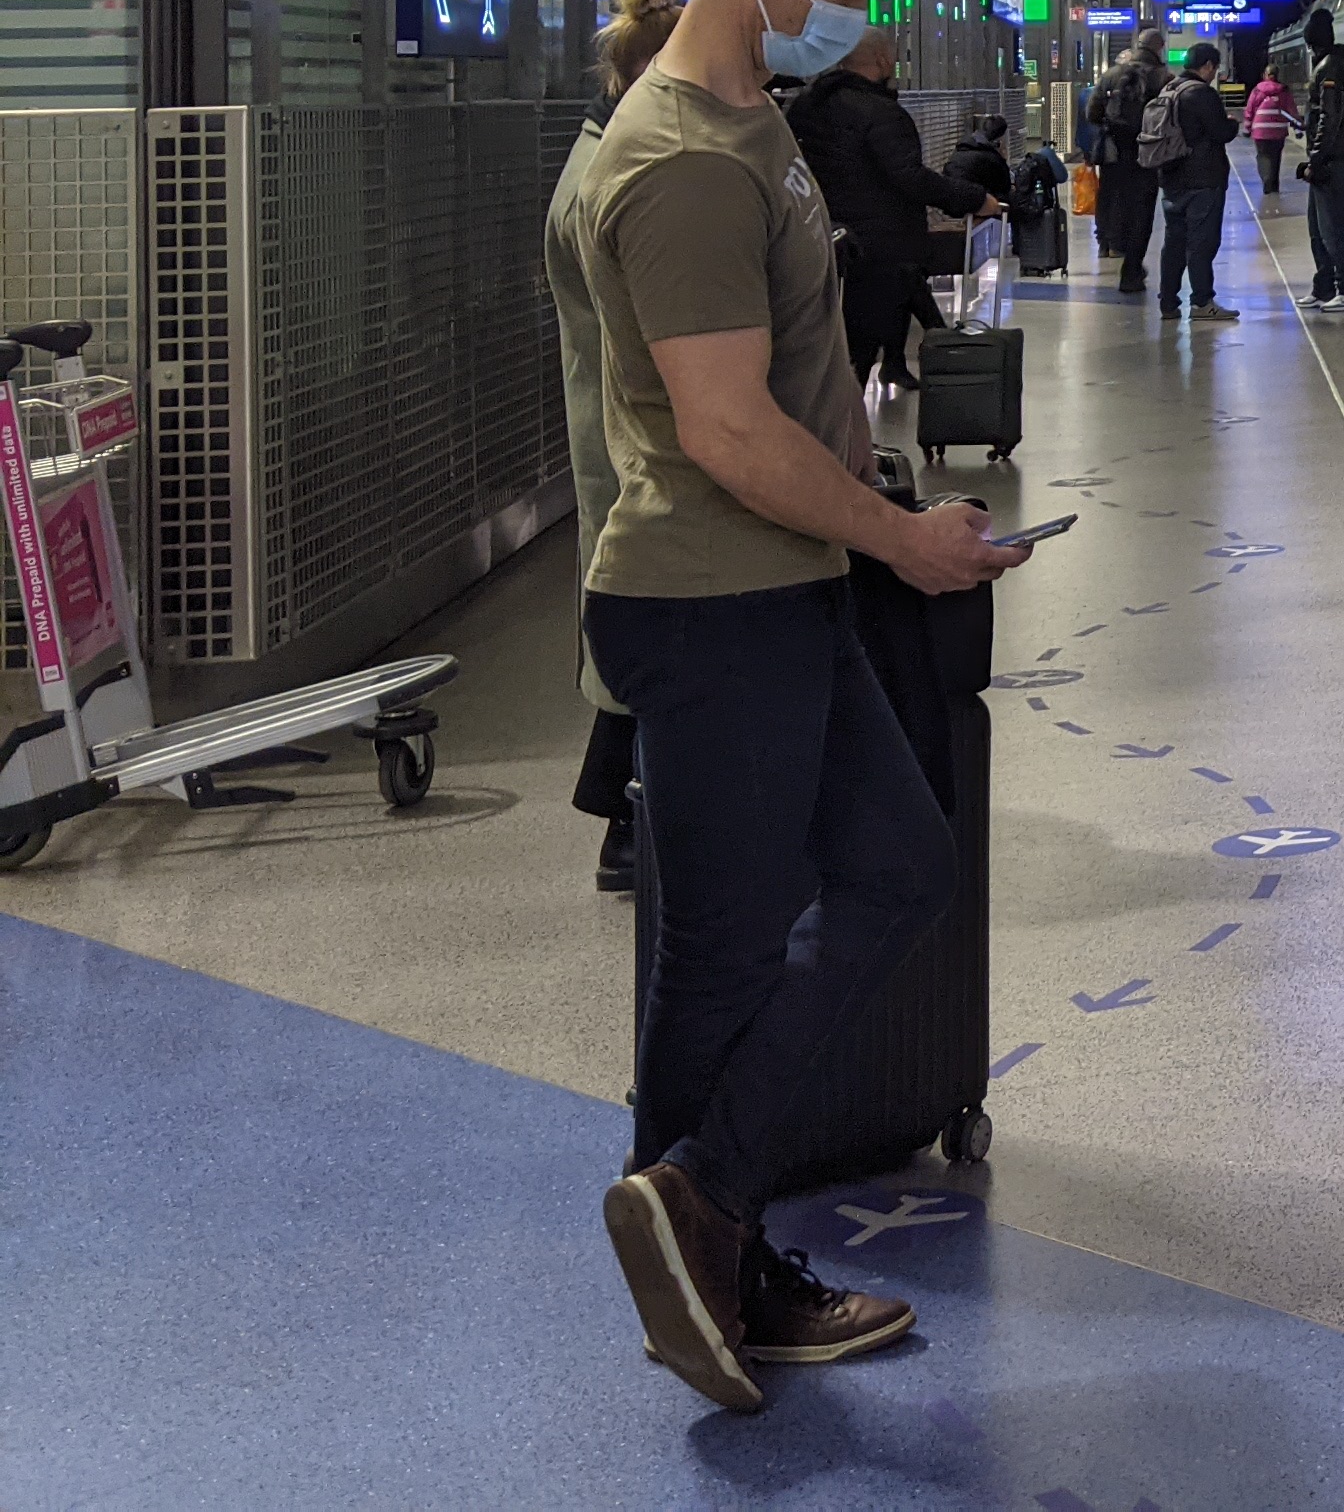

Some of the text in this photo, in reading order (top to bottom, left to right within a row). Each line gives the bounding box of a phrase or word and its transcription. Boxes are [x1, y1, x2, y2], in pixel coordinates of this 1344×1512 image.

[2, 425, 51, 642] DNA Prepaid with unlimited data
